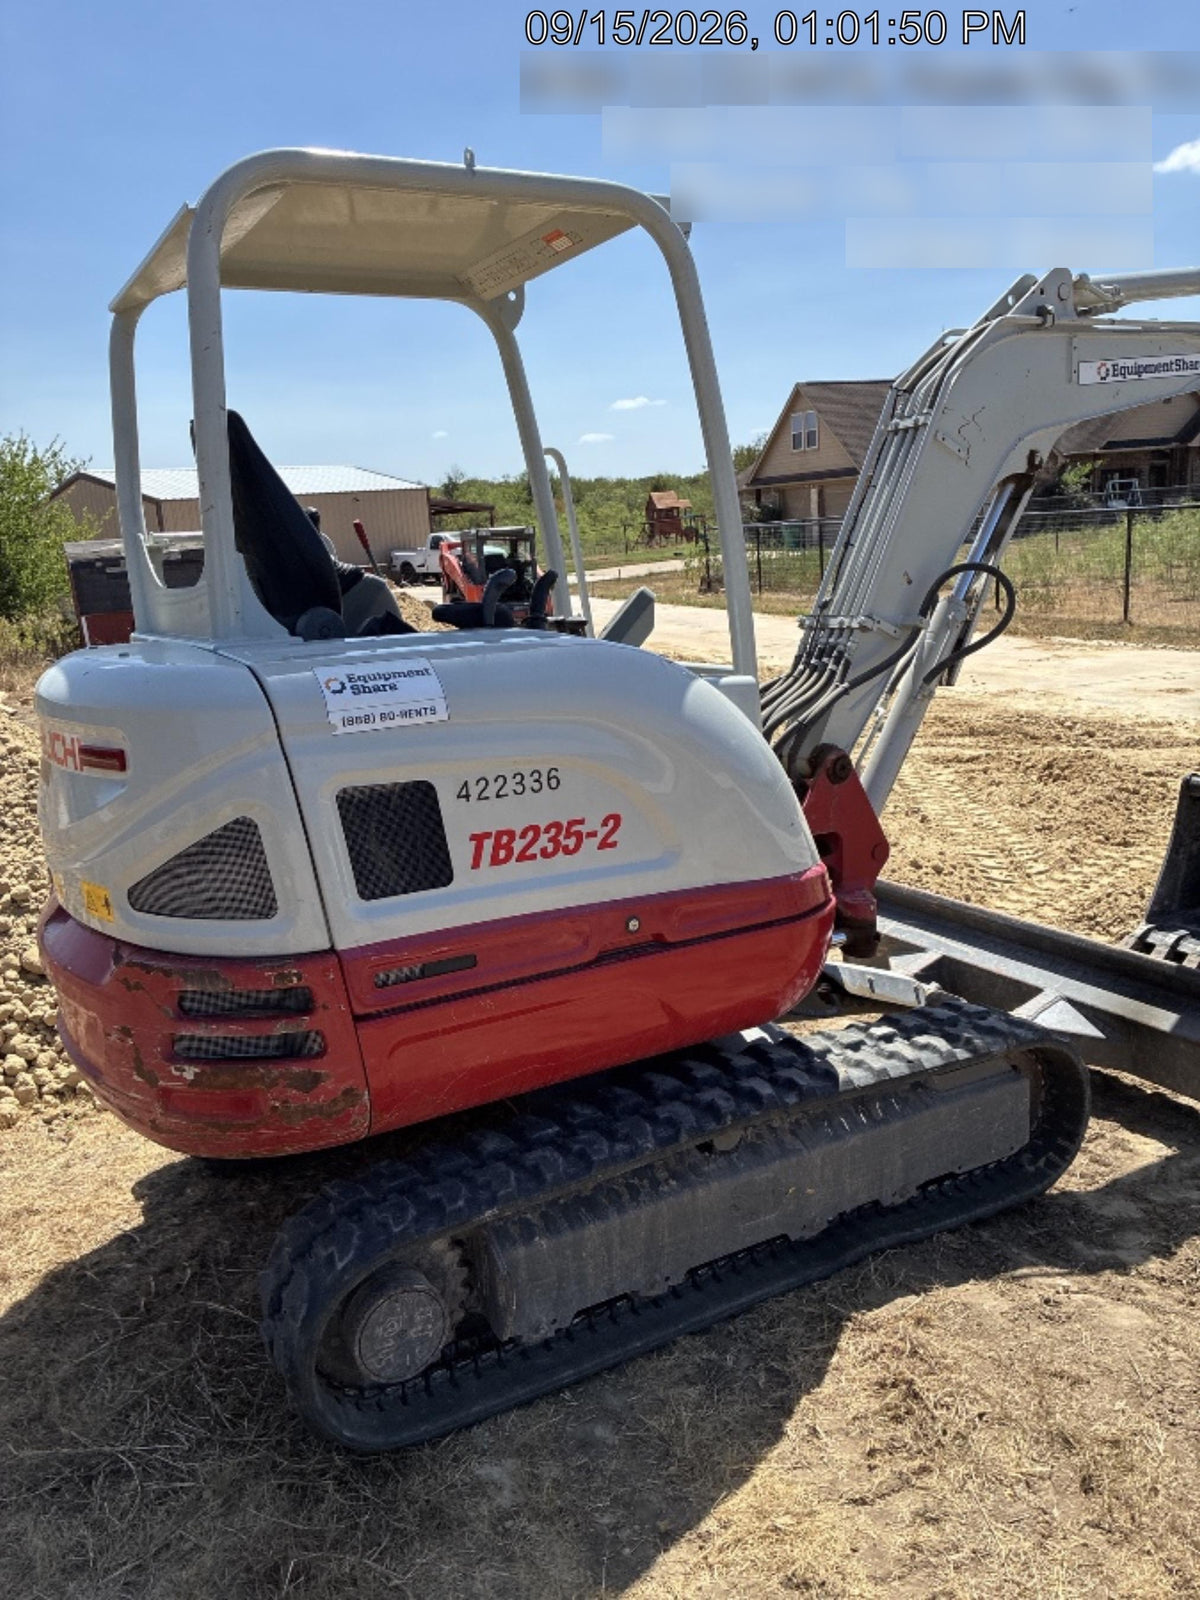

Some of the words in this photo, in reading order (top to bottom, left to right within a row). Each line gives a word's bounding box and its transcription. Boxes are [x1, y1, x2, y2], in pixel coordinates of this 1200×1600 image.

[1111, 358, 1200, 379] EquipmentShar
[346, 667, 431, 684] Equipment
[351, 683, 398, 695] Share
[456, 767, 561, 802] 422336
[469, 813, 622, 870] TB235-2
